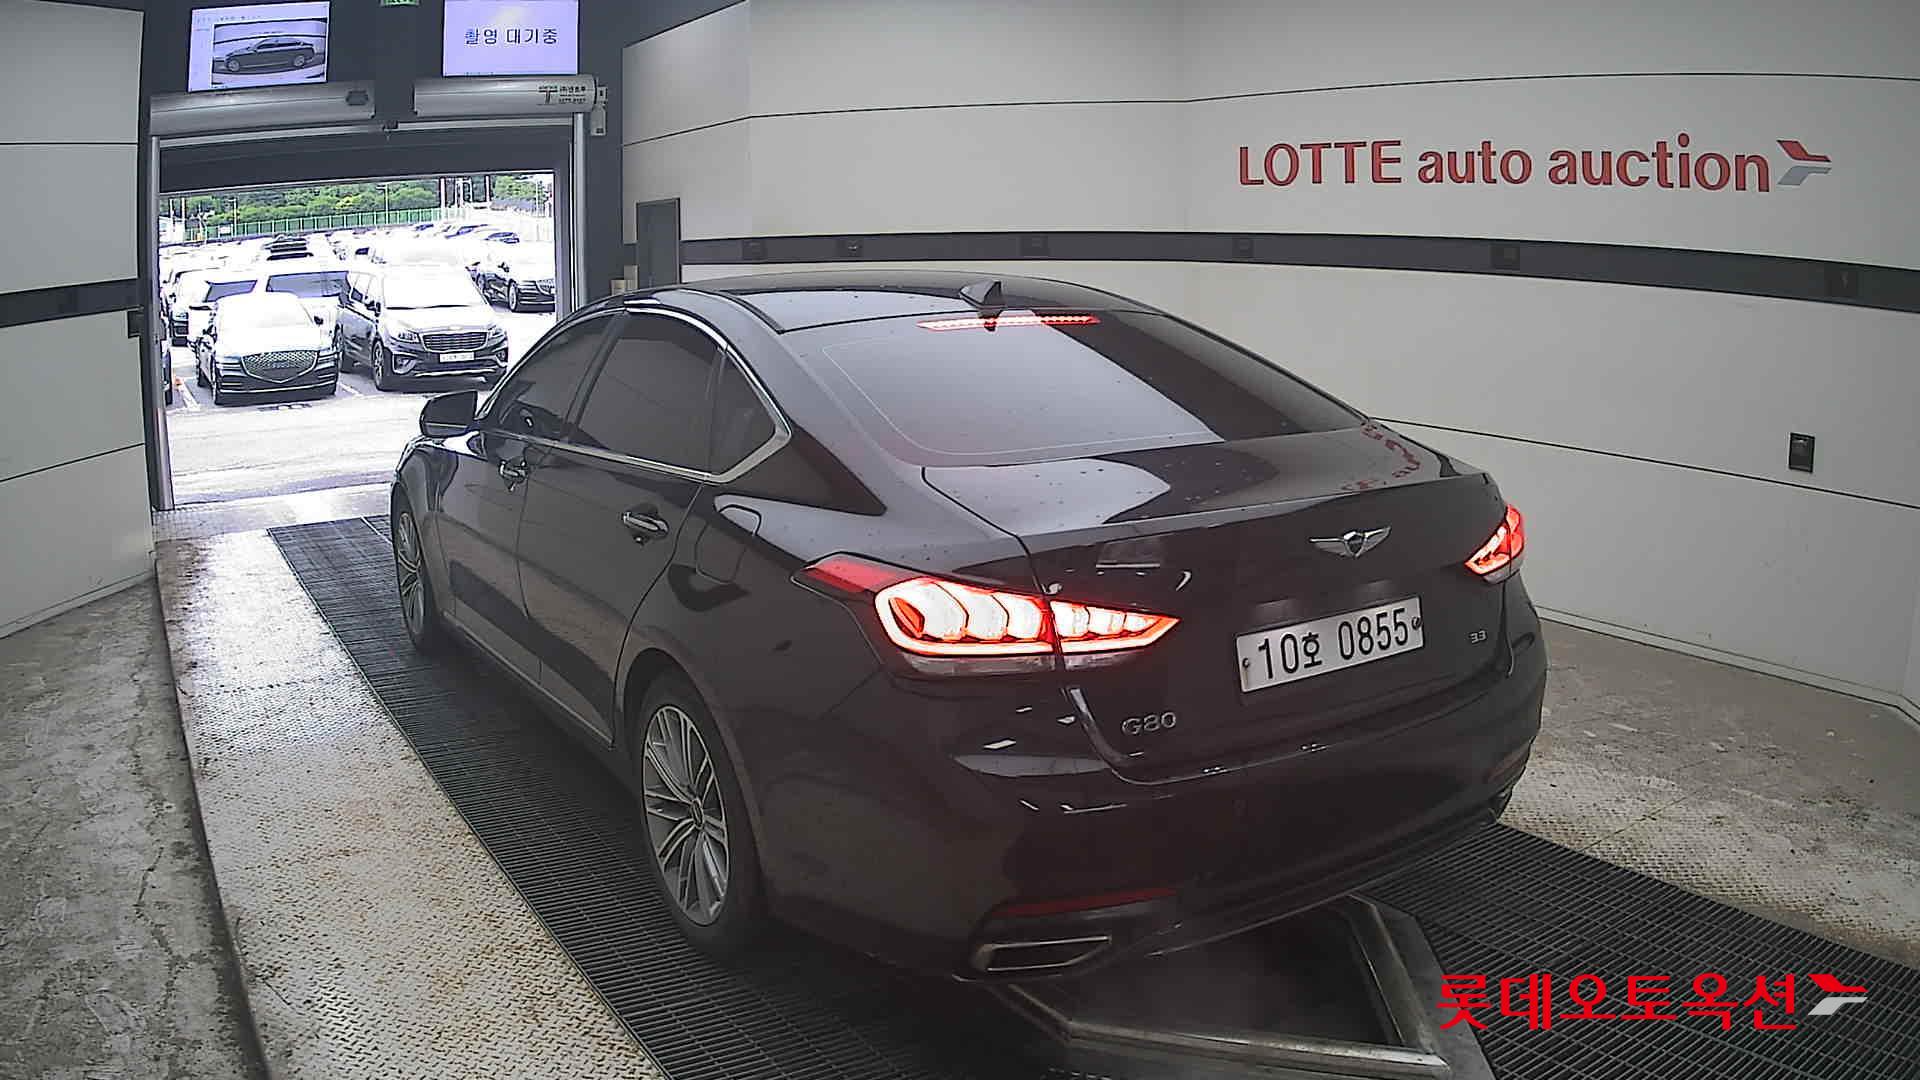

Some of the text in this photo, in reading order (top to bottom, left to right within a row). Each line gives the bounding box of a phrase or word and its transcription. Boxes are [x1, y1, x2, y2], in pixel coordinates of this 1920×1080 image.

[506, 28, 558, 45] 대기중
[1239, 132, 1770, 192] LOTTE auto auction
[1257, 607, 1409, 680] 10호 0855
[1121, 711, 1177, 735] G80
